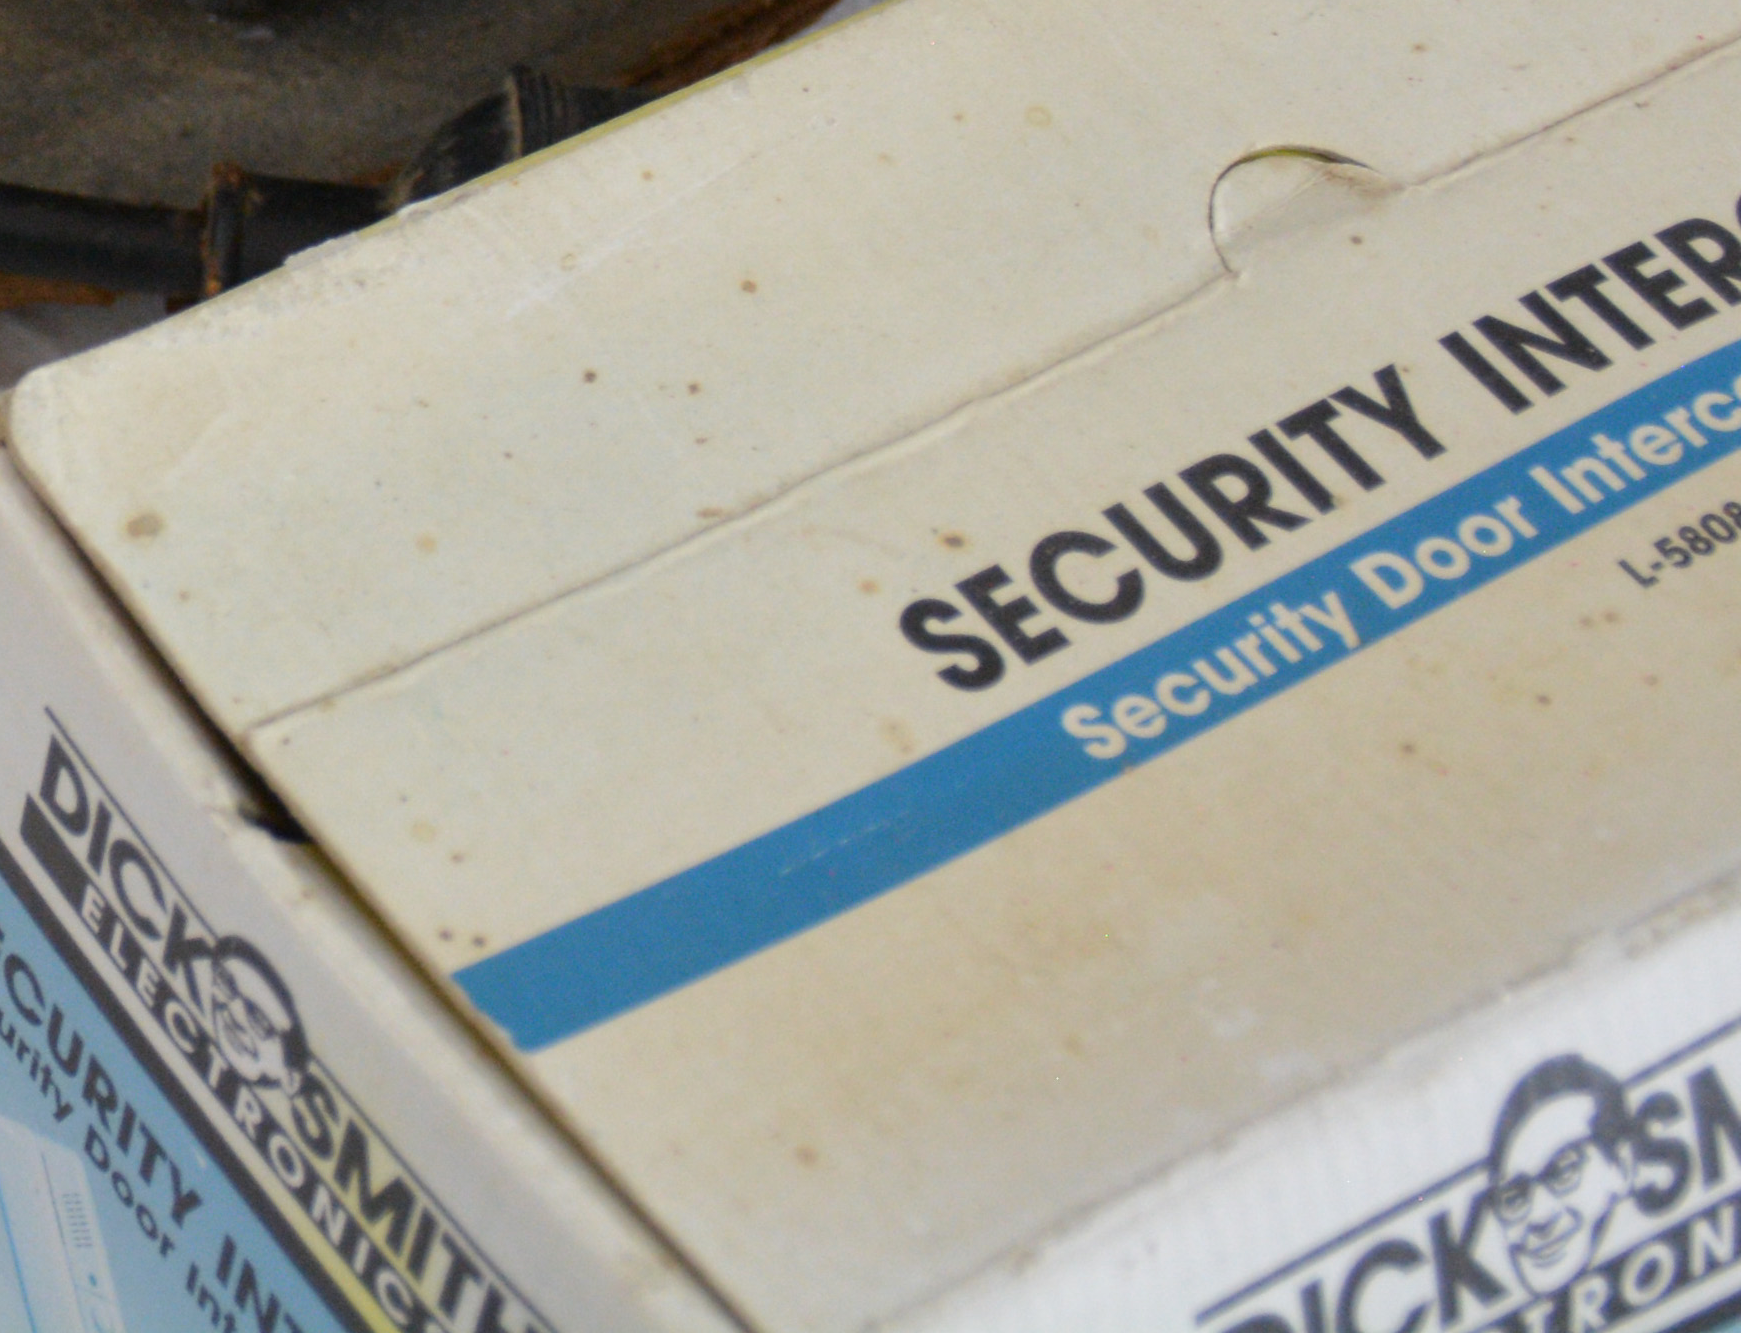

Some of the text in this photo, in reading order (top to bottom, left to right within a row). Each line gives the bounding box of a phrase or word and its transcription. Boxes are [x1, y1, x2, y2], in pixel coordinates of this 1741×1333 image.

[898, 194, 1741, 692] SECURITY INTER
[1061, 371, 1741, 760] Security Door Interc
[39, 733, 219, 1017] DICK
[81, 885, 443, 1333] ELECTRONIC
[84, 1124, 176, 1265] Door
[217, 1234, 303, 1333] IN
[1220, 1186, 1509, 1333] ICK
